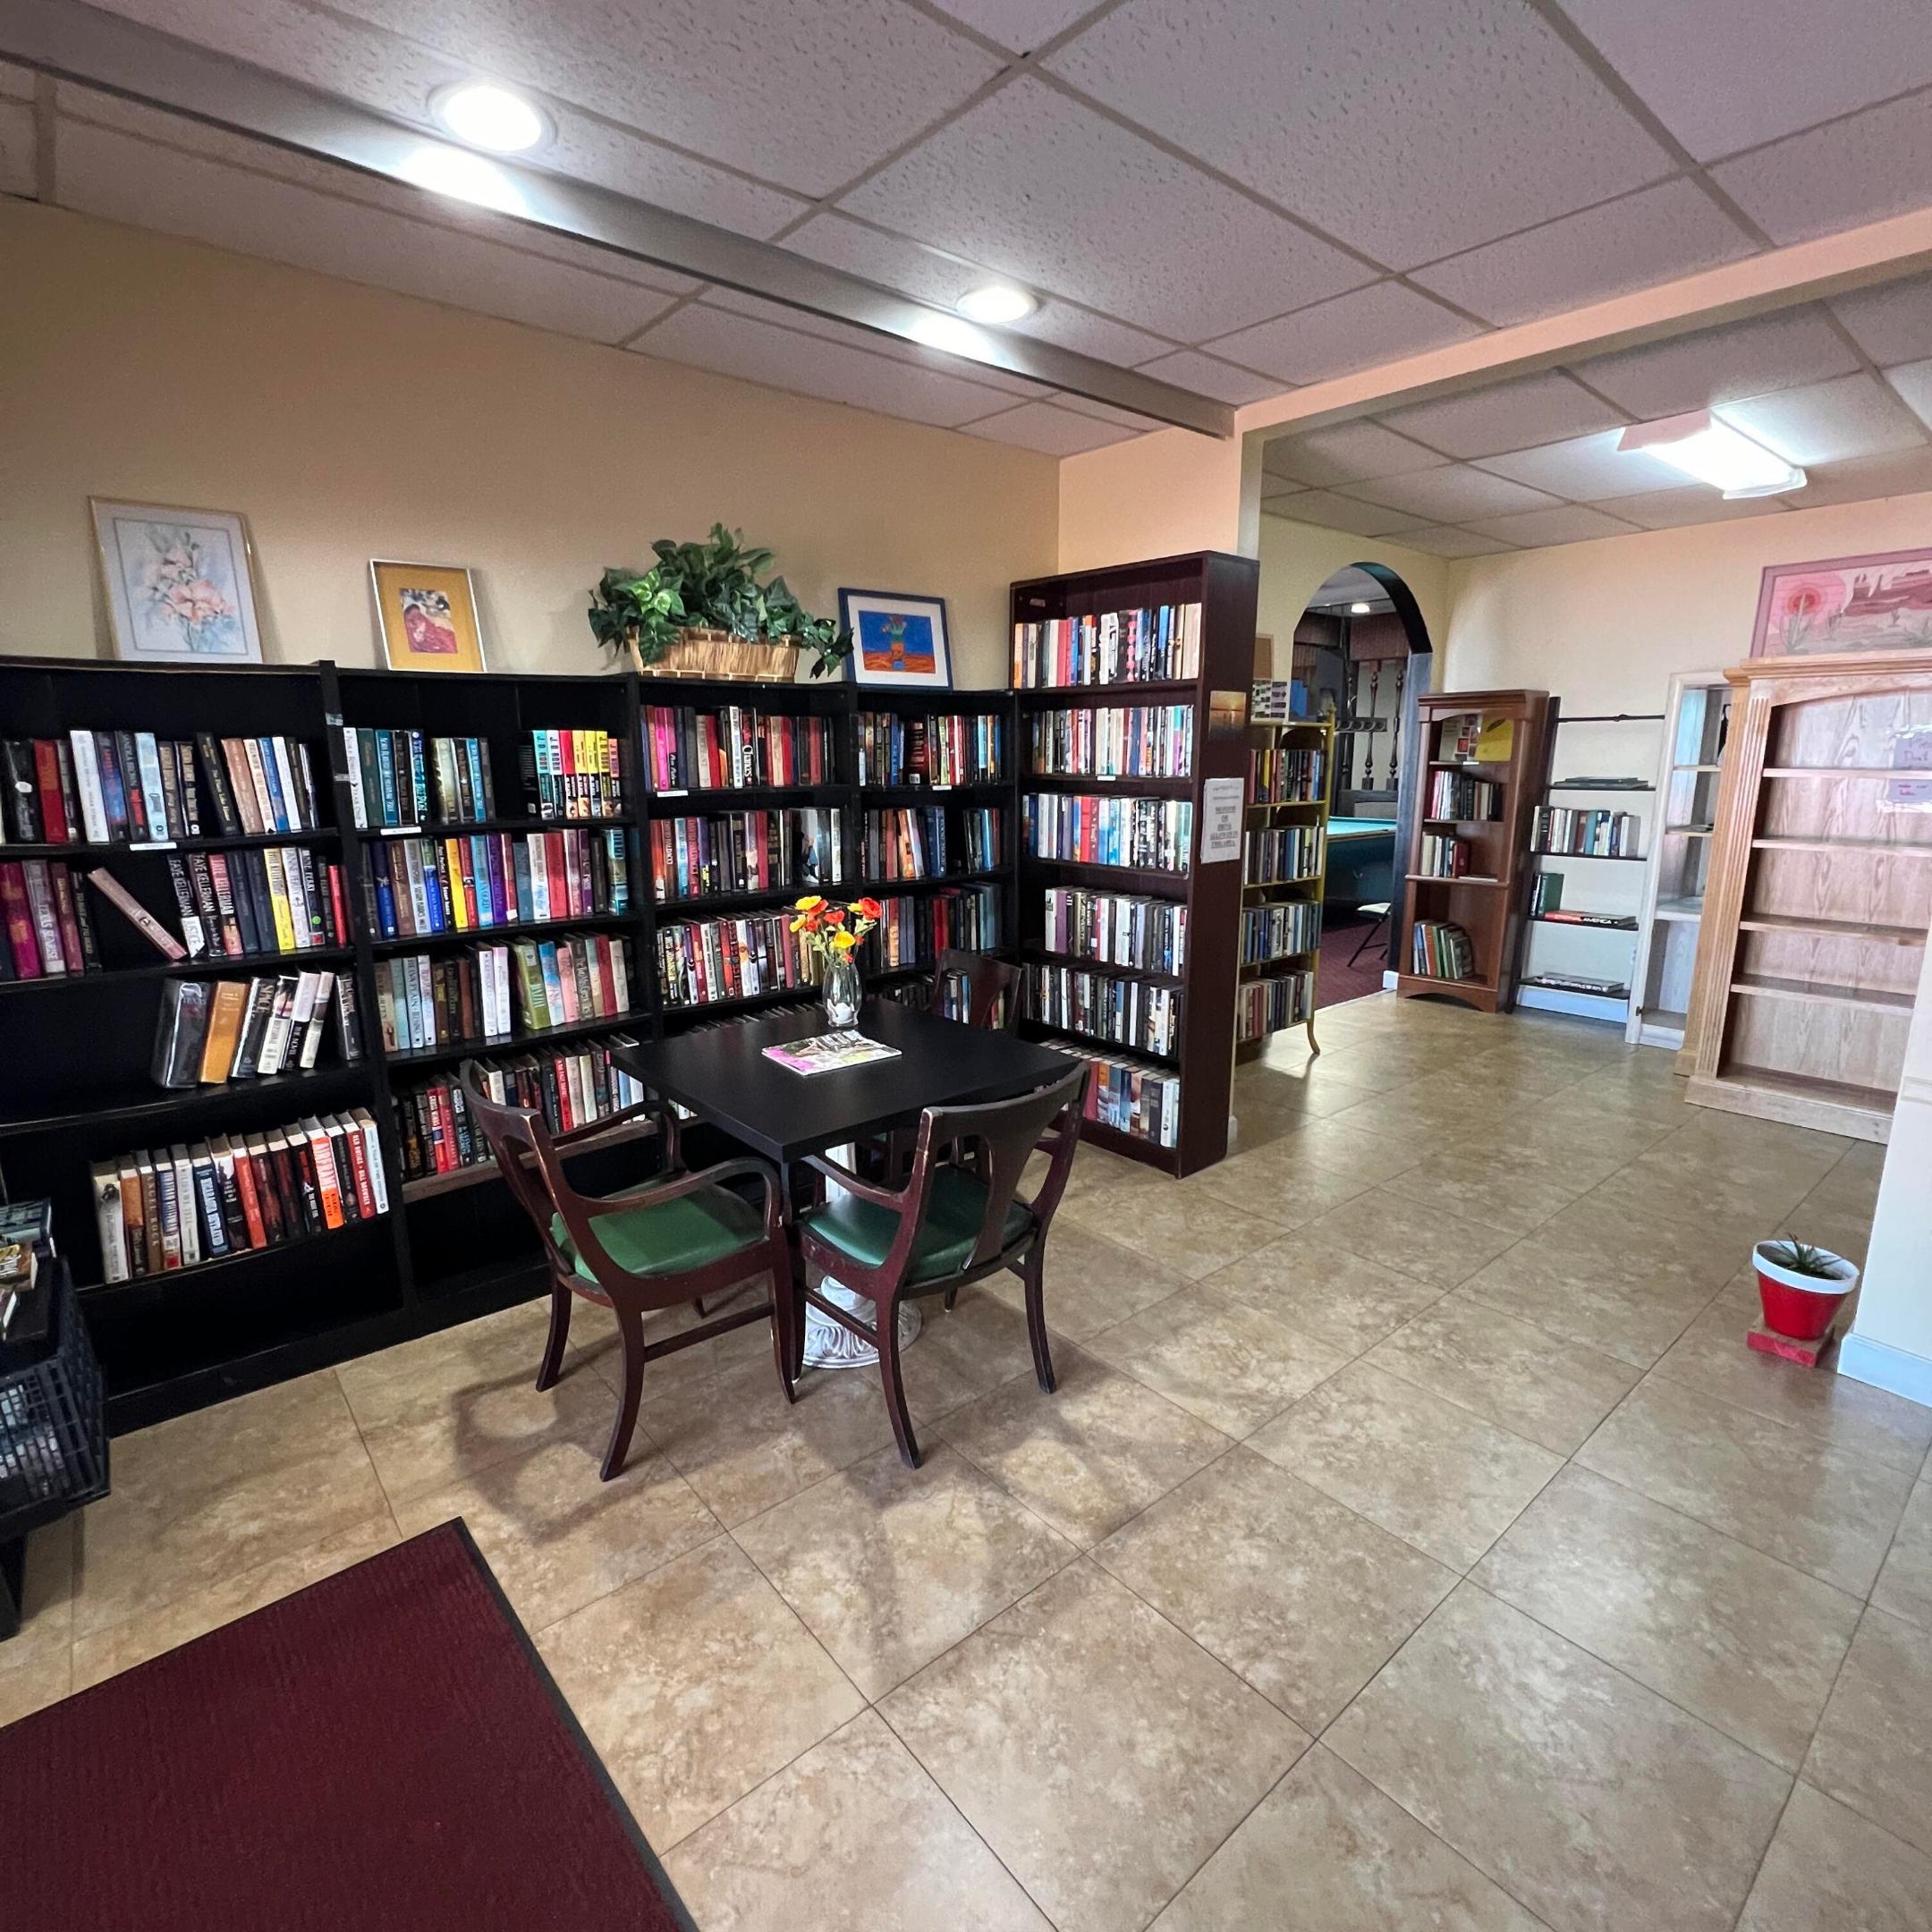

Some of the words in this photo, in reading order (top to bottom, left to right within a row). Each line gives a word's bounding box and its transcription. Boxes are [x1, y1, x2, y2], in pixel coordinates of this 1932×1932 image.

[742, 744, 754, 776] Chances
[169, 859, 183, 877] FAYE
[193, 854, 207, 872] FAYE
[174, 877, 194, 916] KELLERMAN
[196, 873, 216, 911] KELLERMAN
[215, 877, 234, 915] KELLERMAN
[42, 929, 57, 960] SUNRISE
[409, 984, 418, 1006] PLAIN
[313, 1143, 336, 1189] AIRFRAME
[147, 1175, 157, 1211] ANGEL
[150, 1216, 159, 1246] ROCK
